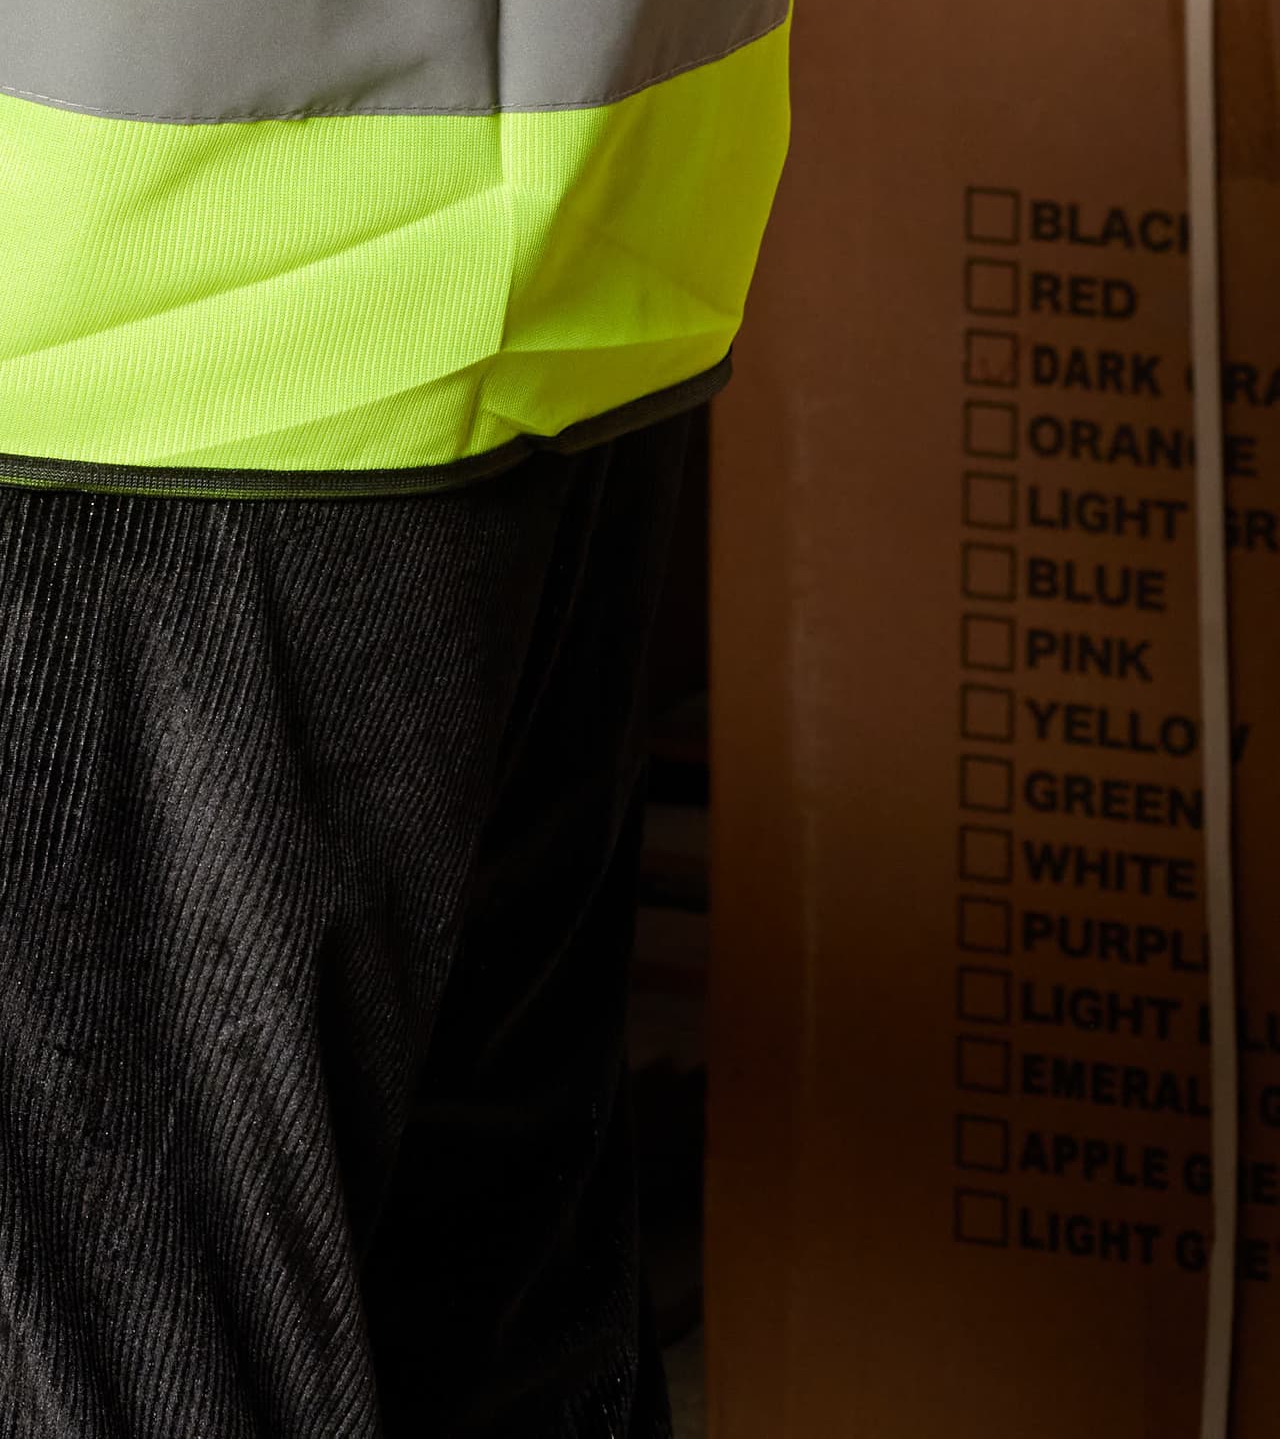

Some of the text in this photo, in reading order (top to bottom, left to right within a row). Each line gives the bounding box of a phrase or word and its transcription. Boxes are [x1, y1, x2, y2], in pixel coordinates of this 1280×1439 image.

[1029, 271, 1138, 320] RED
[1032, 344, 1163, 395] DARK
[1028, 414, 1256, 477] ORANE
[1028, 486, 1188, 541] LIGHT
[1025, 556, 1167, 613] BLUE
[1025, 629, 1152, 682] PINK
[1024, 839, 1198, 901] WHITE
[1022, 982, 1180, 1042] LIGHT
[1022, 1053, 1246, 1123] EMERAL
[1020, 1133, 1169, 1192] APPLE
[1019, 1208, 1160, 1264] LIGHT
